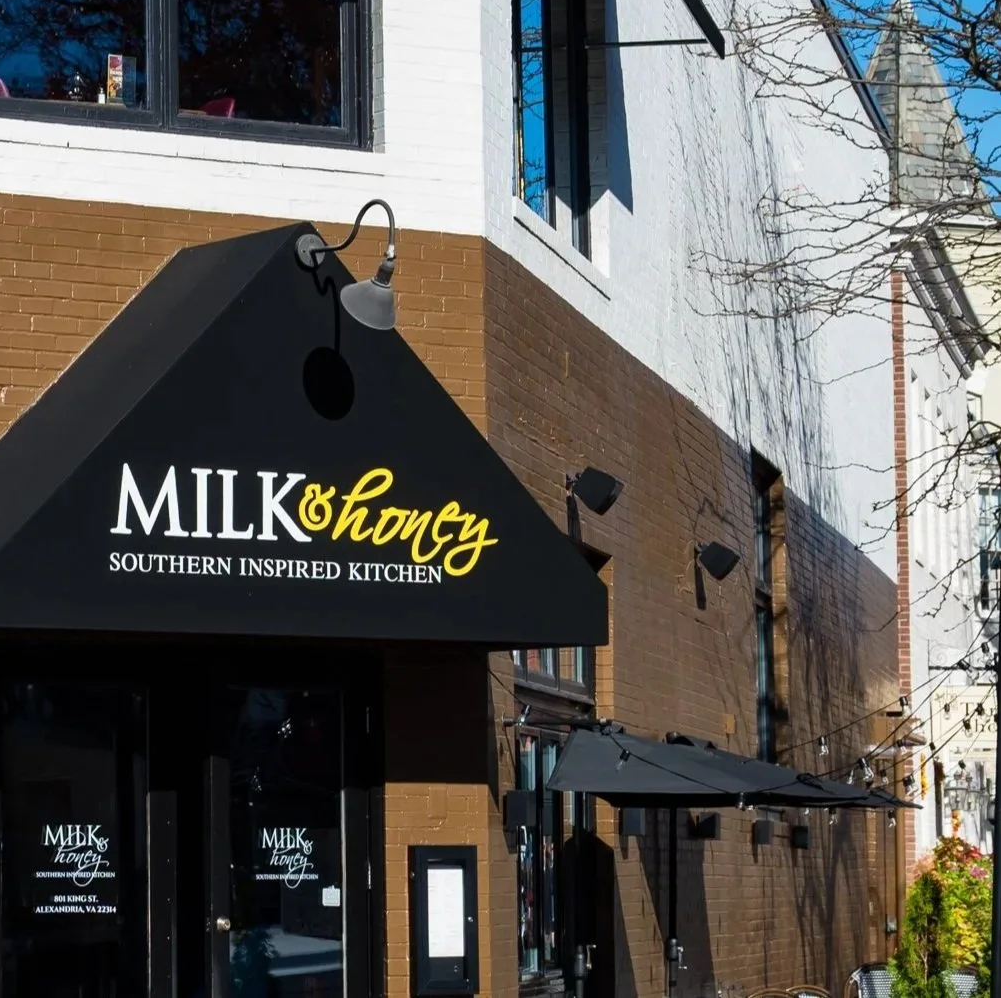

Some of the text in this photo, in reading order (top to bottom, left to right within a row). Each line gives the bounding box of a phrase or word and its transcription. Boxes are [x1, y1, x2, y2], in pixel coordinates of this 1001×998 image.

[109, 462, 313, 543] MILK
[109, 551, 443, 584] SOUTHERN INSPIRED KITCHEN
[35, 905, 117, 914] ALEXANDRIA, VA 22314
[67, 895, 87, 903] KING
[87, 895, 99, 903] ST.
